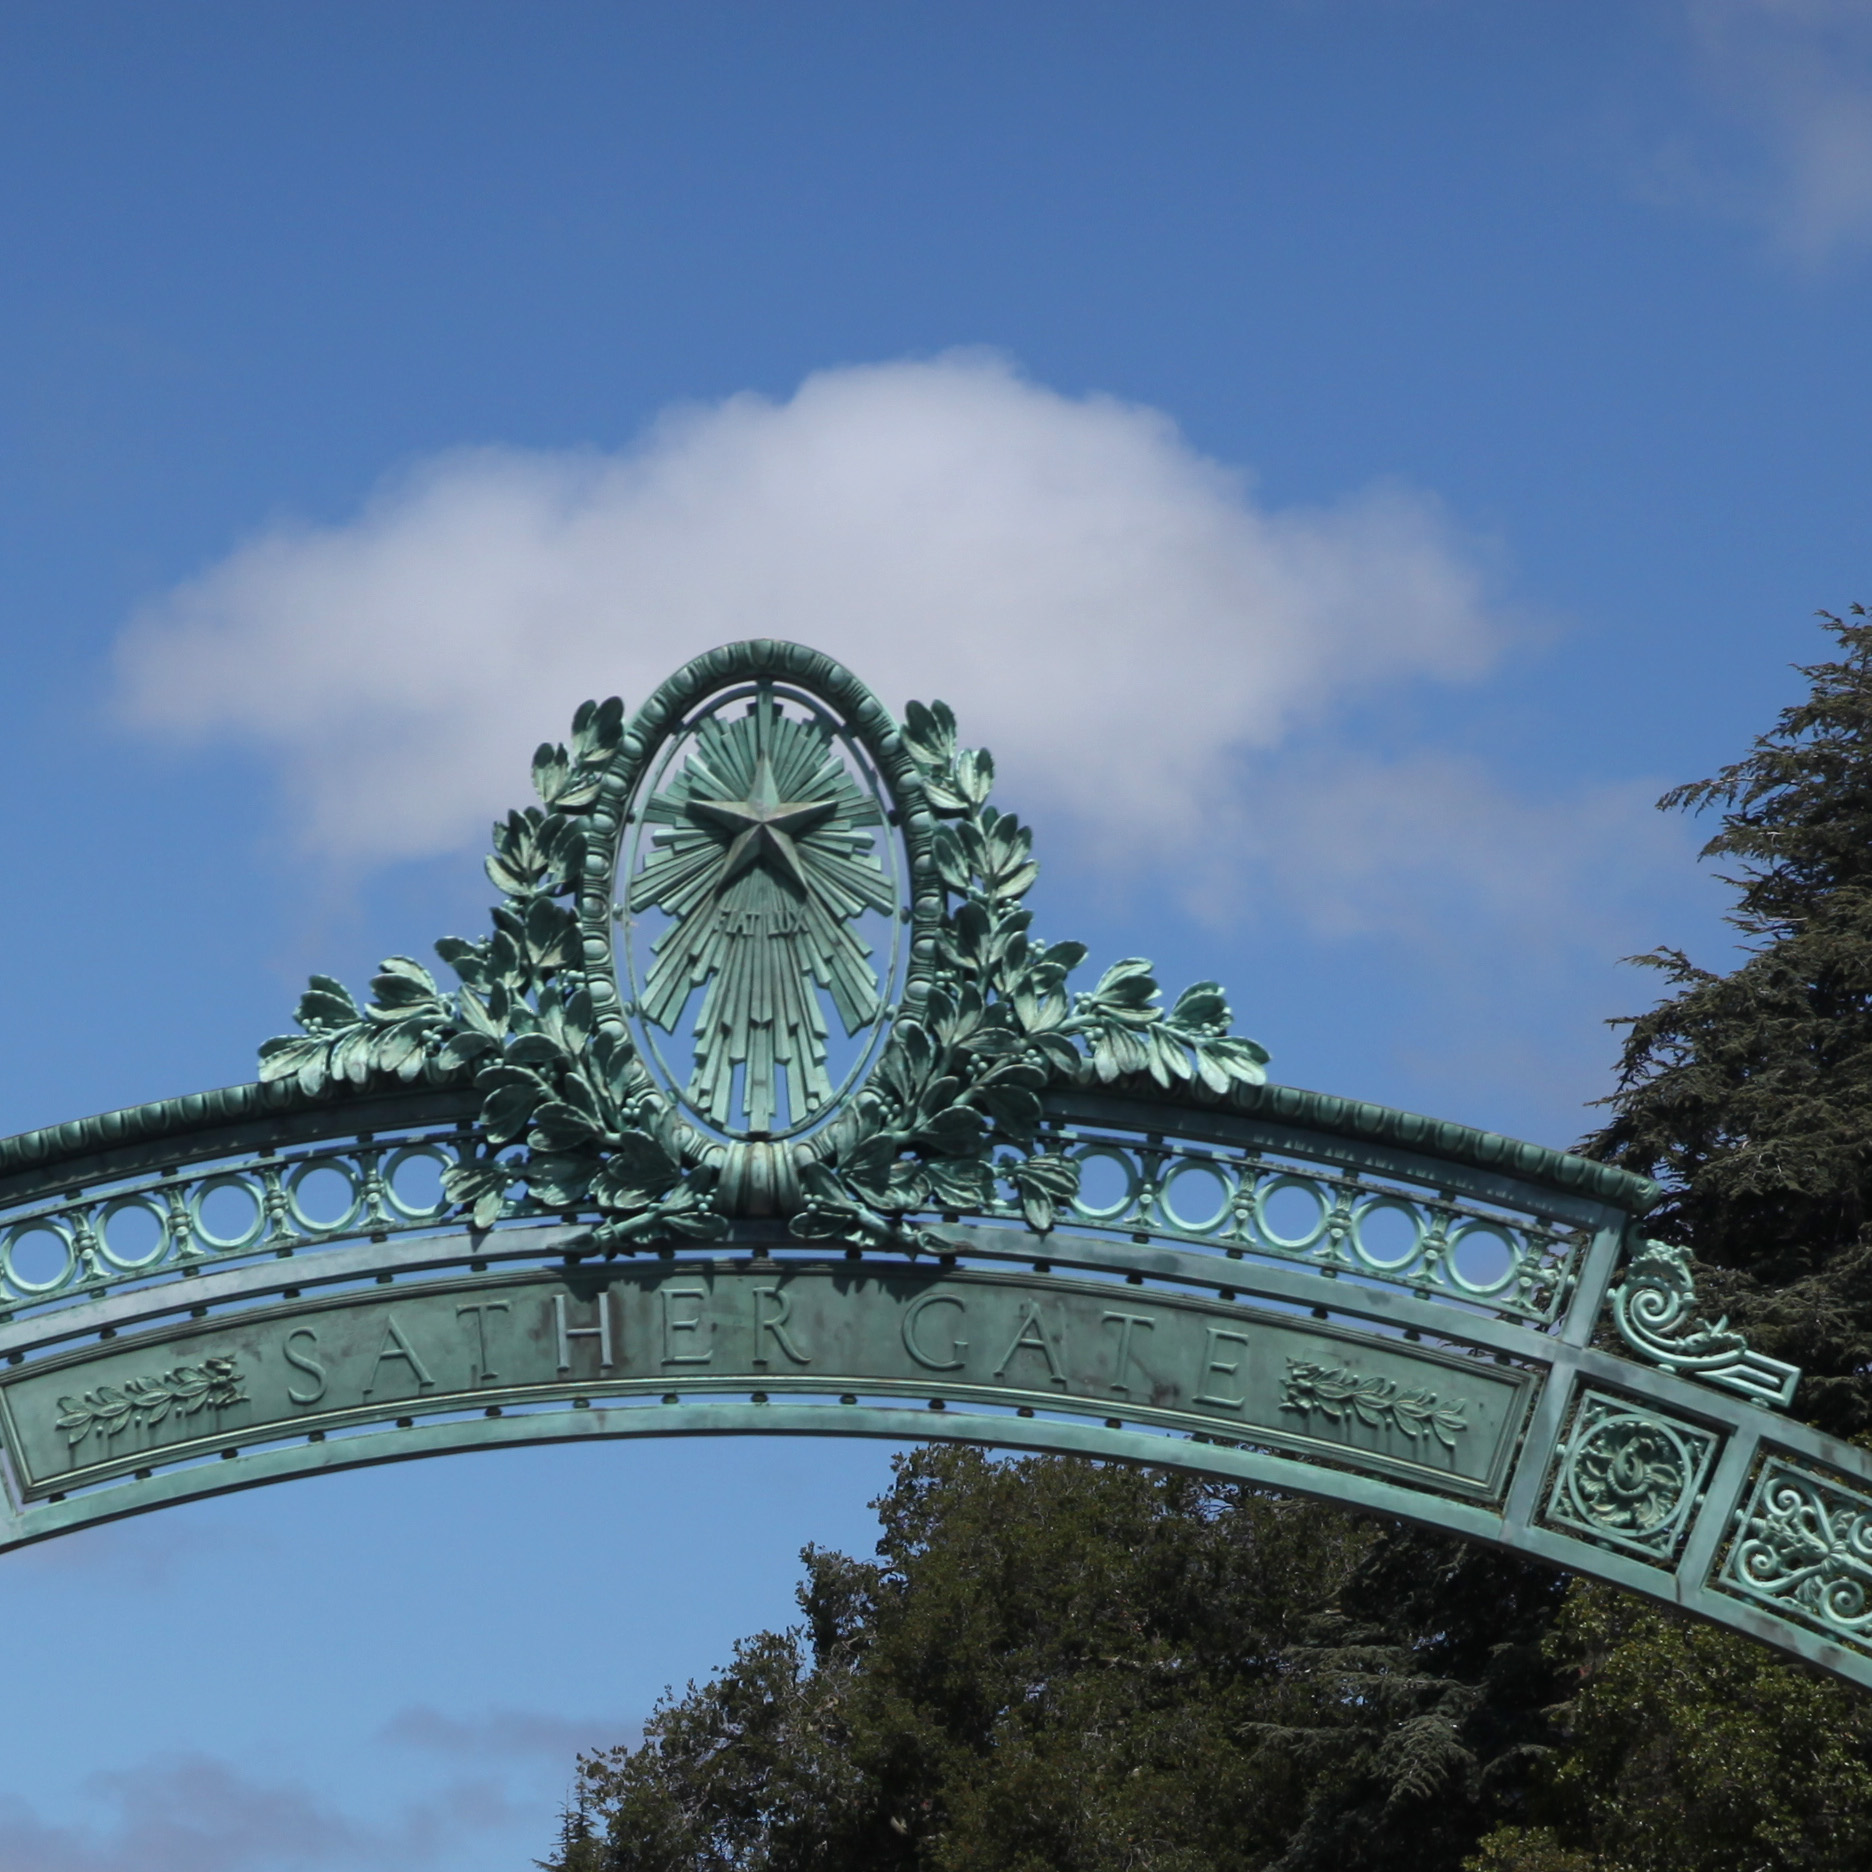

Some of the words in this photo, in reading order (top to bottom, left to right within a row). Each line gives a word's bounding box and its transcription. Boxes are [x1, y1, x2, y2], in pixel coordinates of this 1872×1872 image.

[714, 906, 760, 936] FIAT
[767, 905, 810, 937] LUX
[282, 1285, 812, 1403] SATHER
[900, 1292, 1250, 1409] GATE
